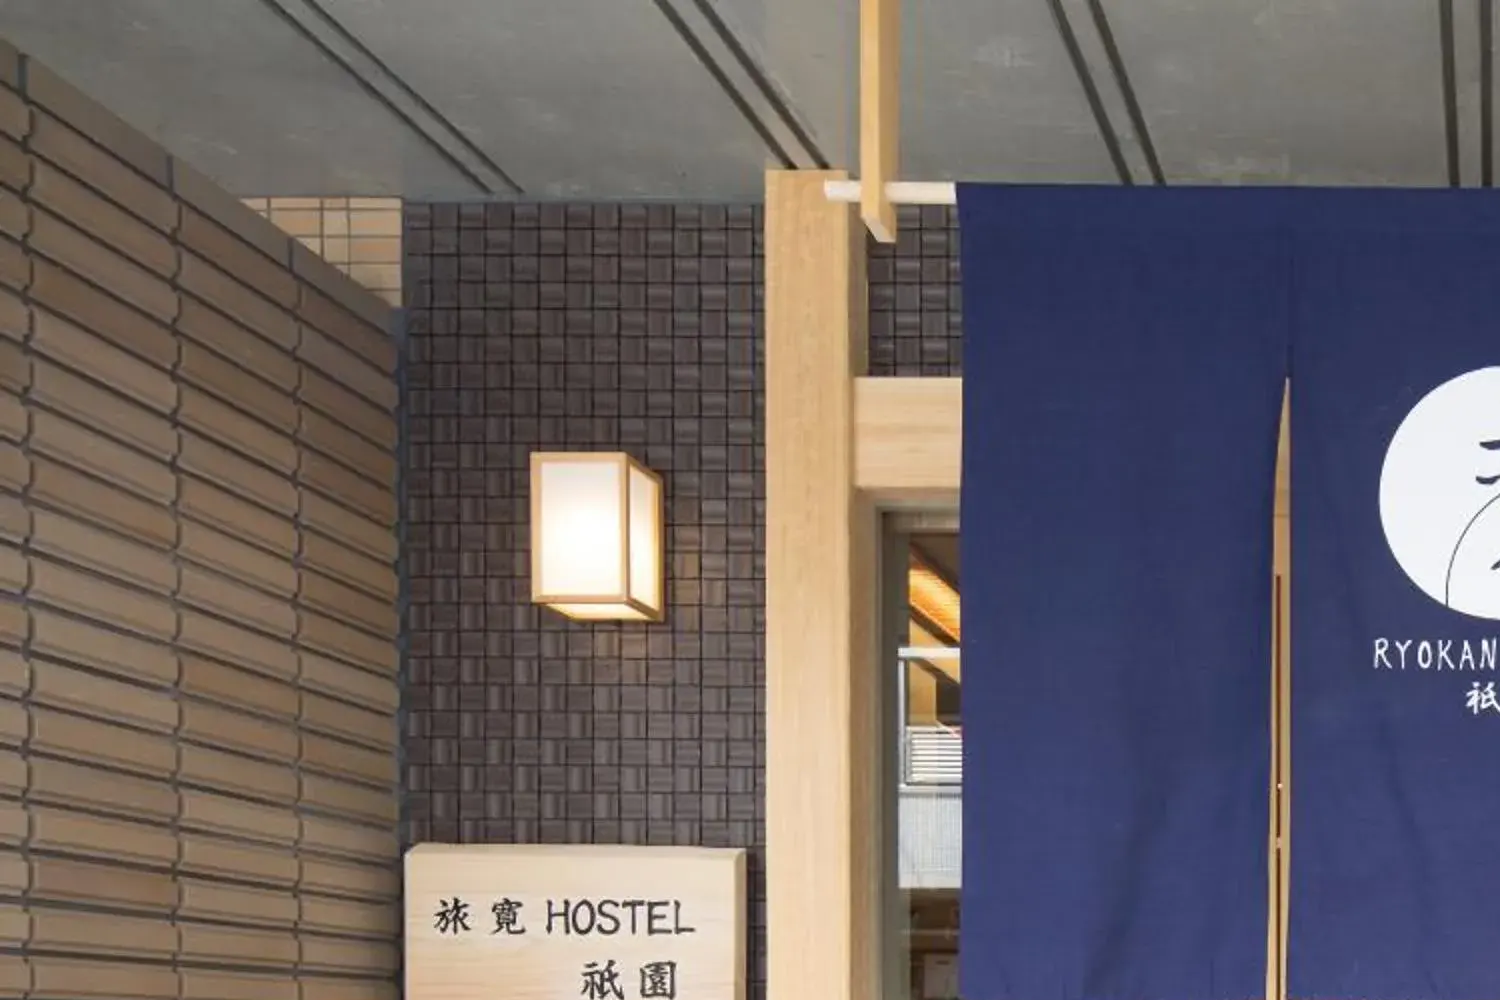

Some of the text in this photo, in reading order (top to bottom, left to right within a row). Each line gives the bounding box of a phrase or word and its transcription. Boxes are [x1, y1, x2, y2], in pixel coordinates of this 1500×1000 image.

[1373, 637, 1497, 670] RYOKAN
[545, 899, 696, 936] HOSTEL
[580, 959, 677, 1000] 祇園
